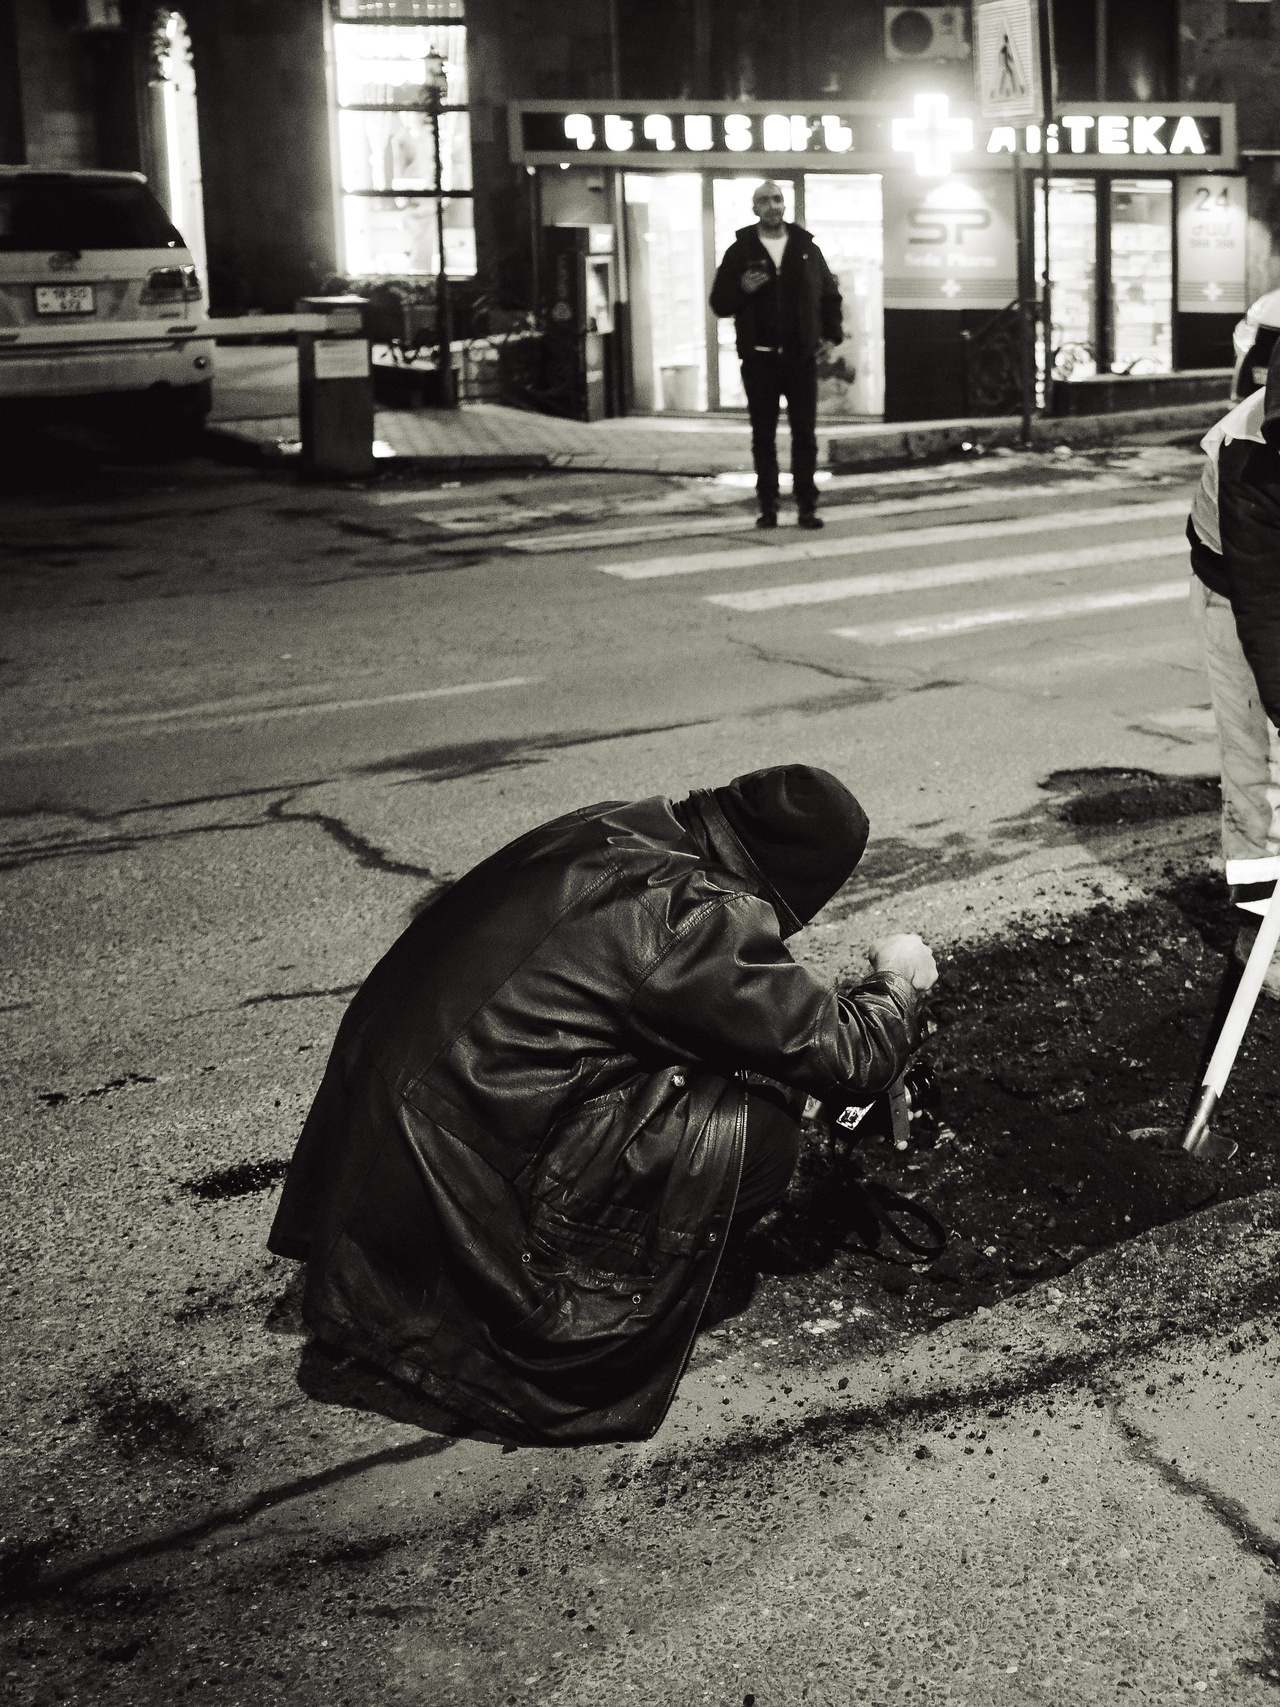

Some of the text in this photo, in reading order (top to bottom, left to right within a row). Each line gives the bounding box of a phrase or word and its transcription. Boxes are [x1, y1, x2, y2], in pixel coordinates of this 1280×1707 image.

[564, 113, 853, 152] ԴԵՂԱՏՈՒՆ
[1195, 186, 1231, 212] 24
[906, 208, 992, 245] SP
